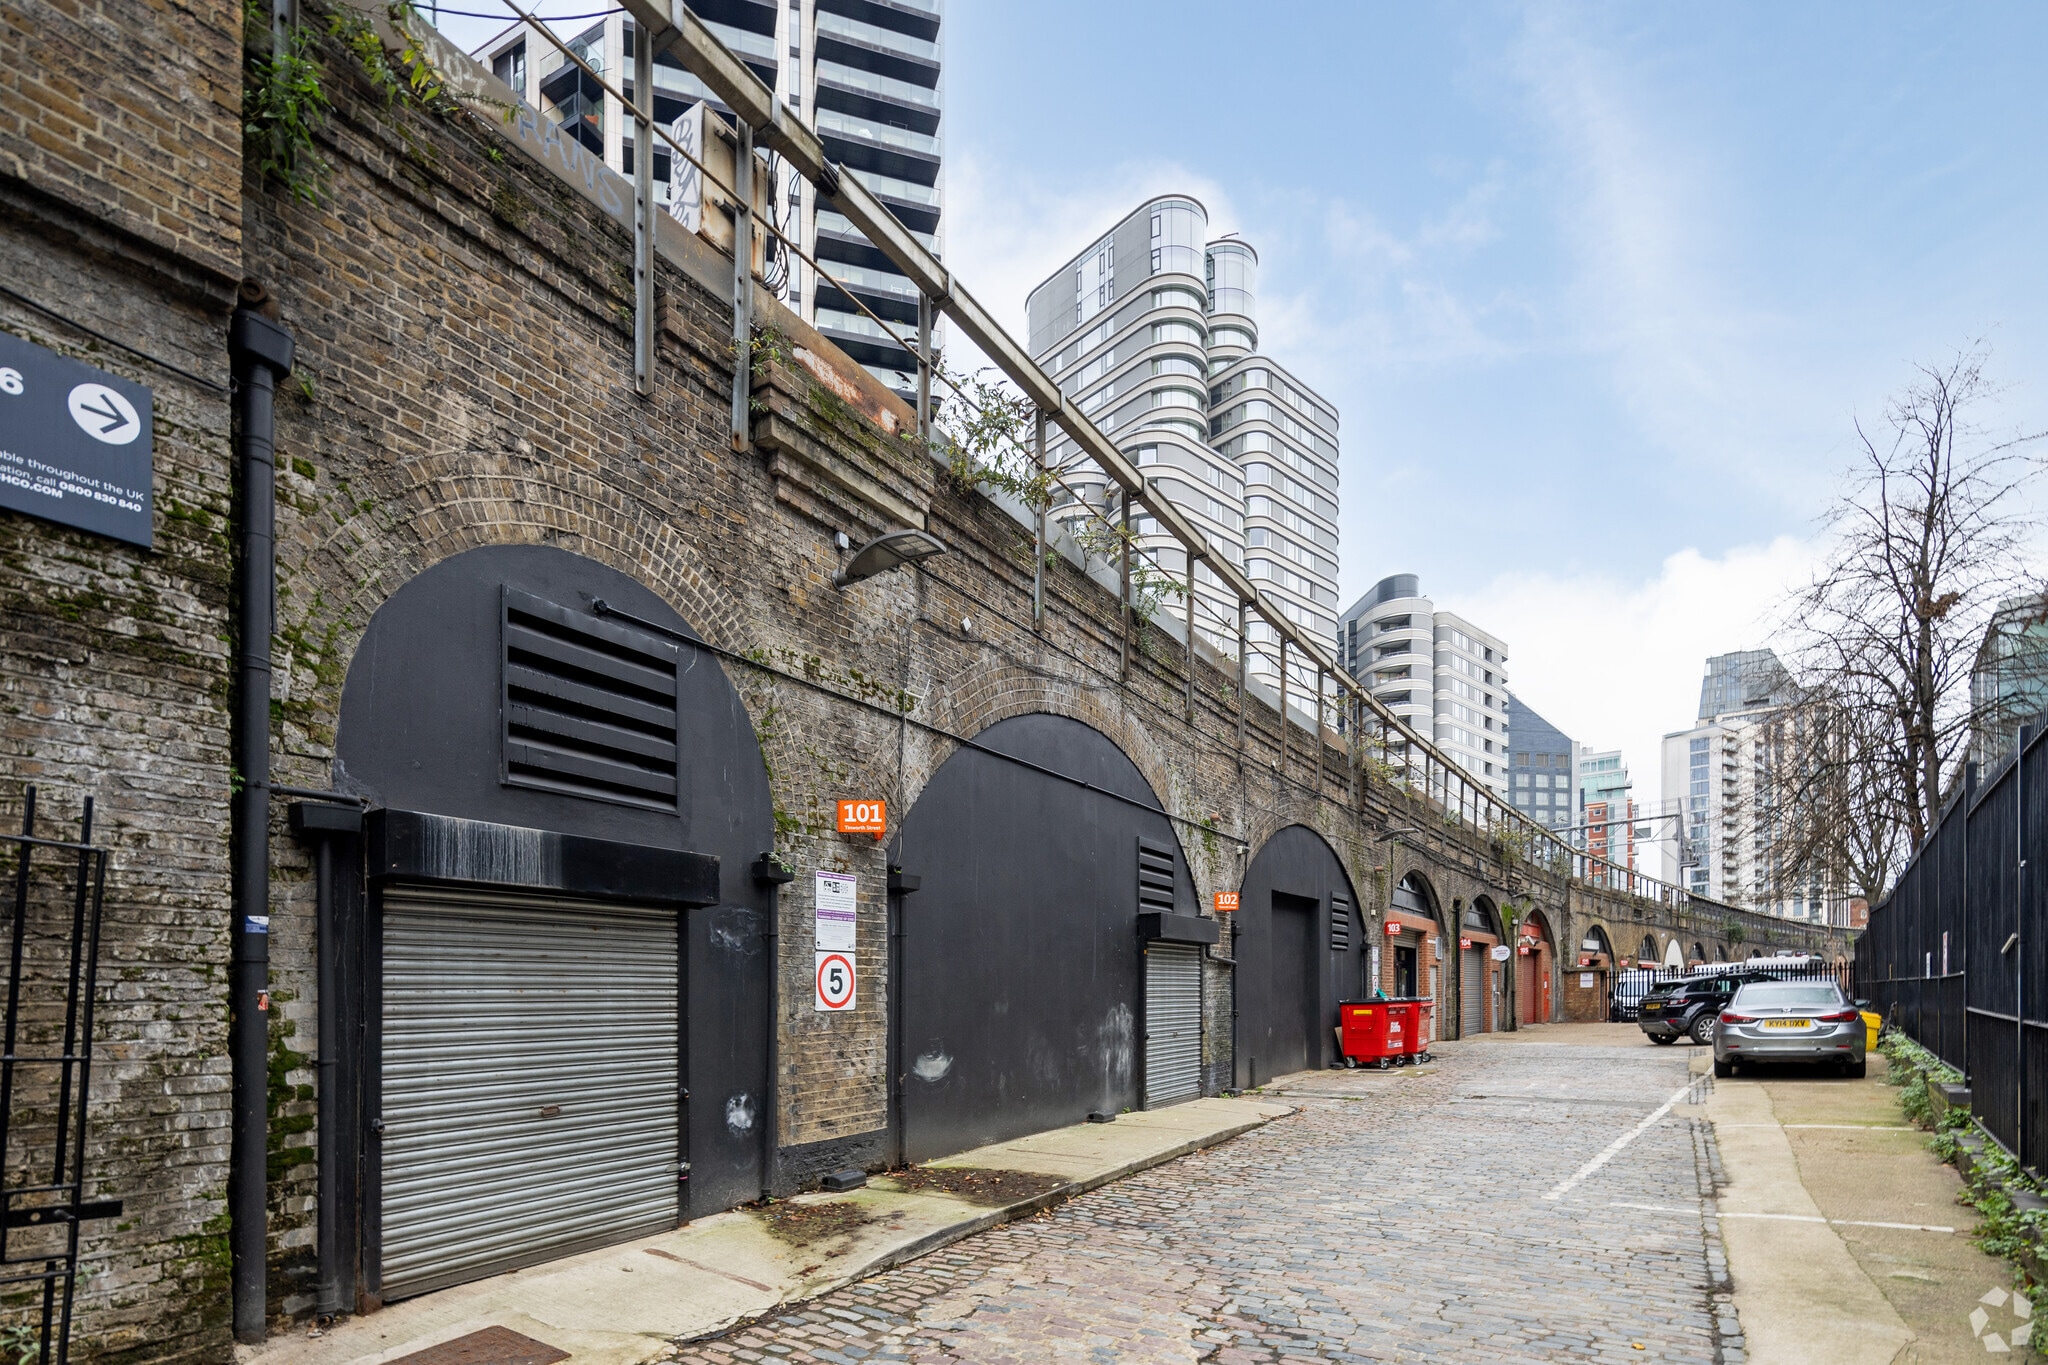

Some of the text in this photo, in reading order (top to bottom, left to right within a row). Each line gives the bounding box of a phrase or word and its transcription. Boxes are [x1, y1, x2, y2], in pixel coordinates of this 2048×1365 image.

[0, 367, 24, 395] 6
[0, 473, 63, 499] HCO.COM
[28, 458, 101, 488] throughout
[104, 482, 124, 495] the
[126, 489, 144, 502] UK
[36, 476, 56, 487] call
[59, 481, 93, 498] 0800
[94, 492, 117, 505] 830
[118, 499, 142, 512] 840
[844, 803, 882, 822] 101
[1218, 894, 1237, 904] 102
[1388, 924, 1400, 932] 103
[830, 968, 843, 995] 5
